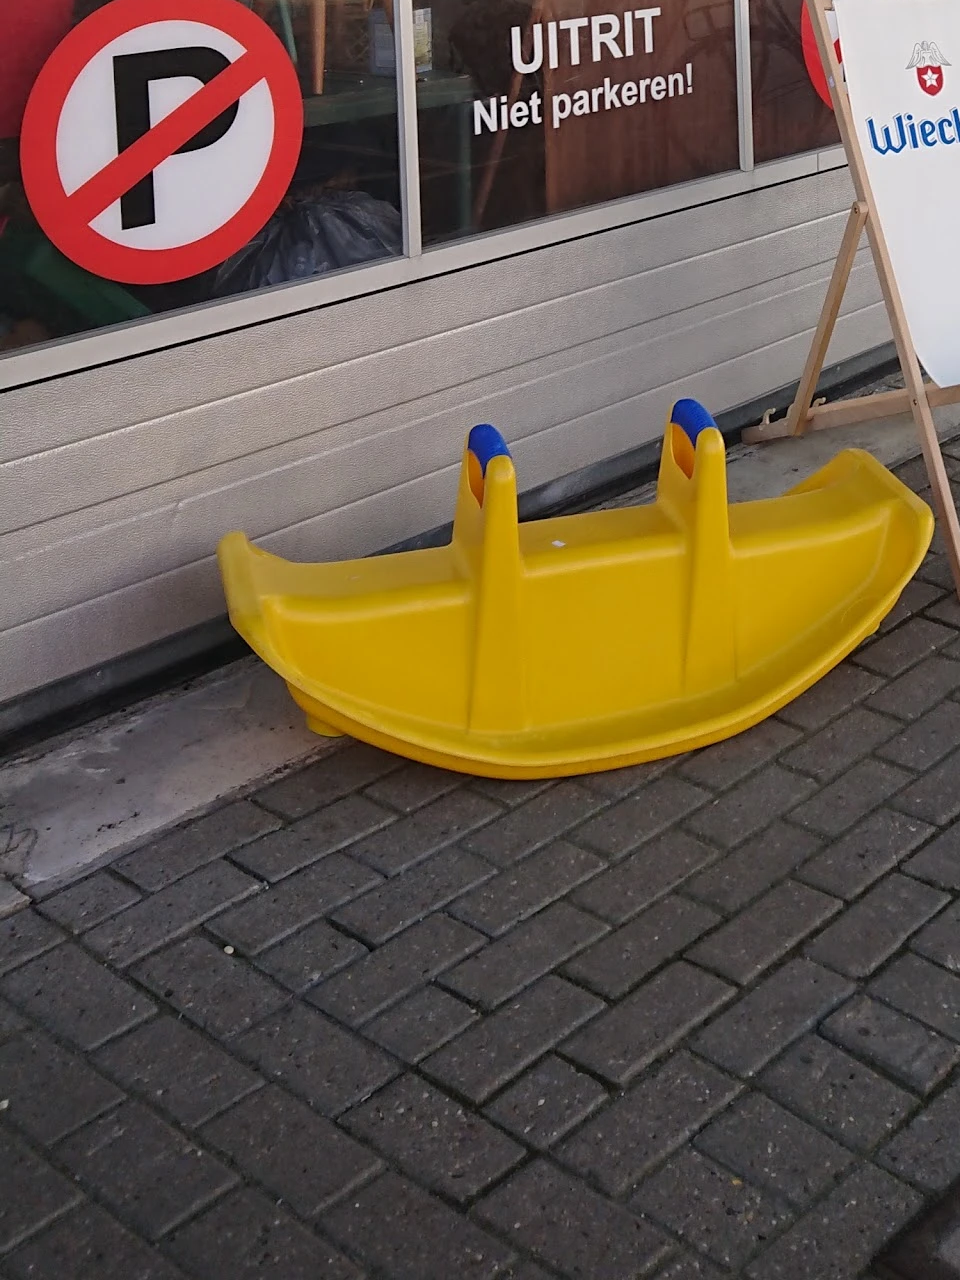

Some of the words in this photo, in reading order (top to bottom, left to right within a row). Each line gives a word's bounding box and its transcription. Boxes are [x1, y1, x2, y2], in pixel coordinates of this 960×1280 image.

[511, 7, 662, 74] UITRIT
[473, 91, 543, 136] Niet
[552, 63, 694, 129] parkeren!
